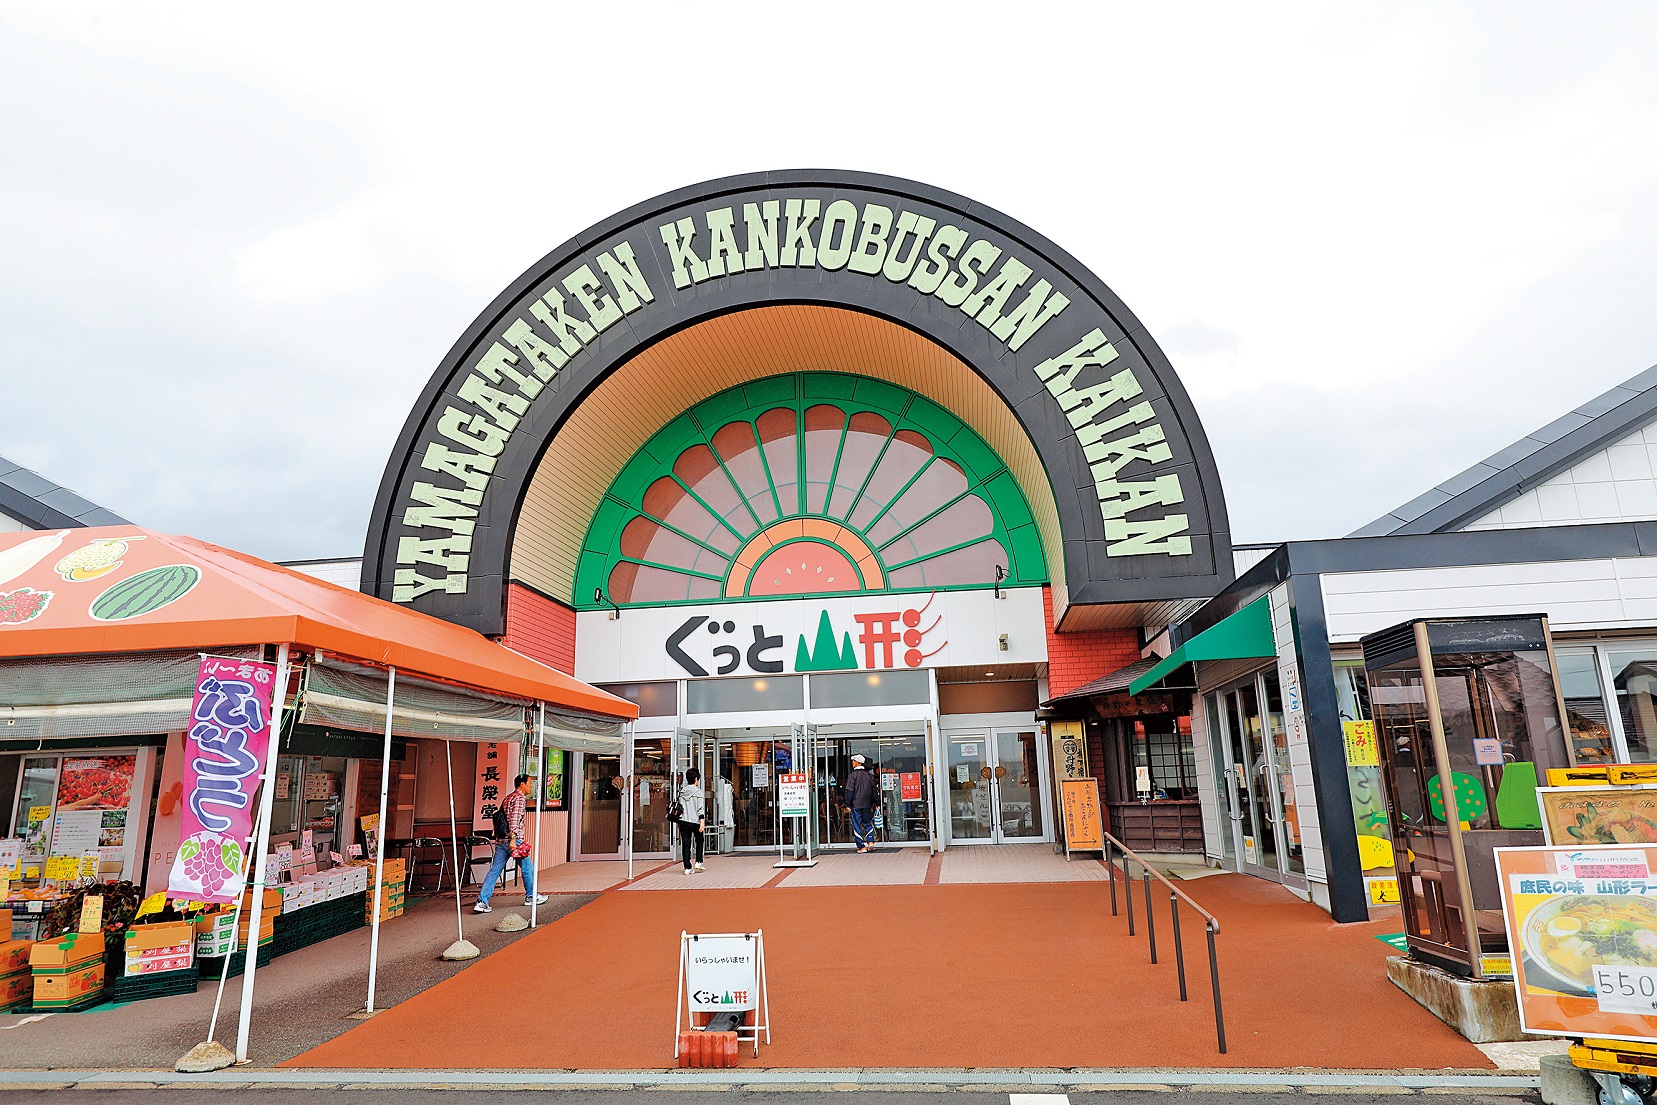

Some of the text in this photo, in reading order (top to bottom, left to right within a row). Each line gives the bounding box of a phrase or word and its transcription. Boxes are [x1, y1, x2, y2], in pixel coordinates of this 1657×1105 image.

[392, 198, 1192, 602] YAMAGATAKEN KANKOBUSSAN KAIKAN
[665, 589, 948, 676] ぐっと山形
[154, 851, 173, 865] PE
[1371, 881, 1399, 889] 段差注
[1519, 880, 1584, 895] 庶民の味
[147, 958, 187, 970] 刈屋梨
[1597, 970, 1655, 997] 550
[692, 986, 753, 1004] ぐっと山形
